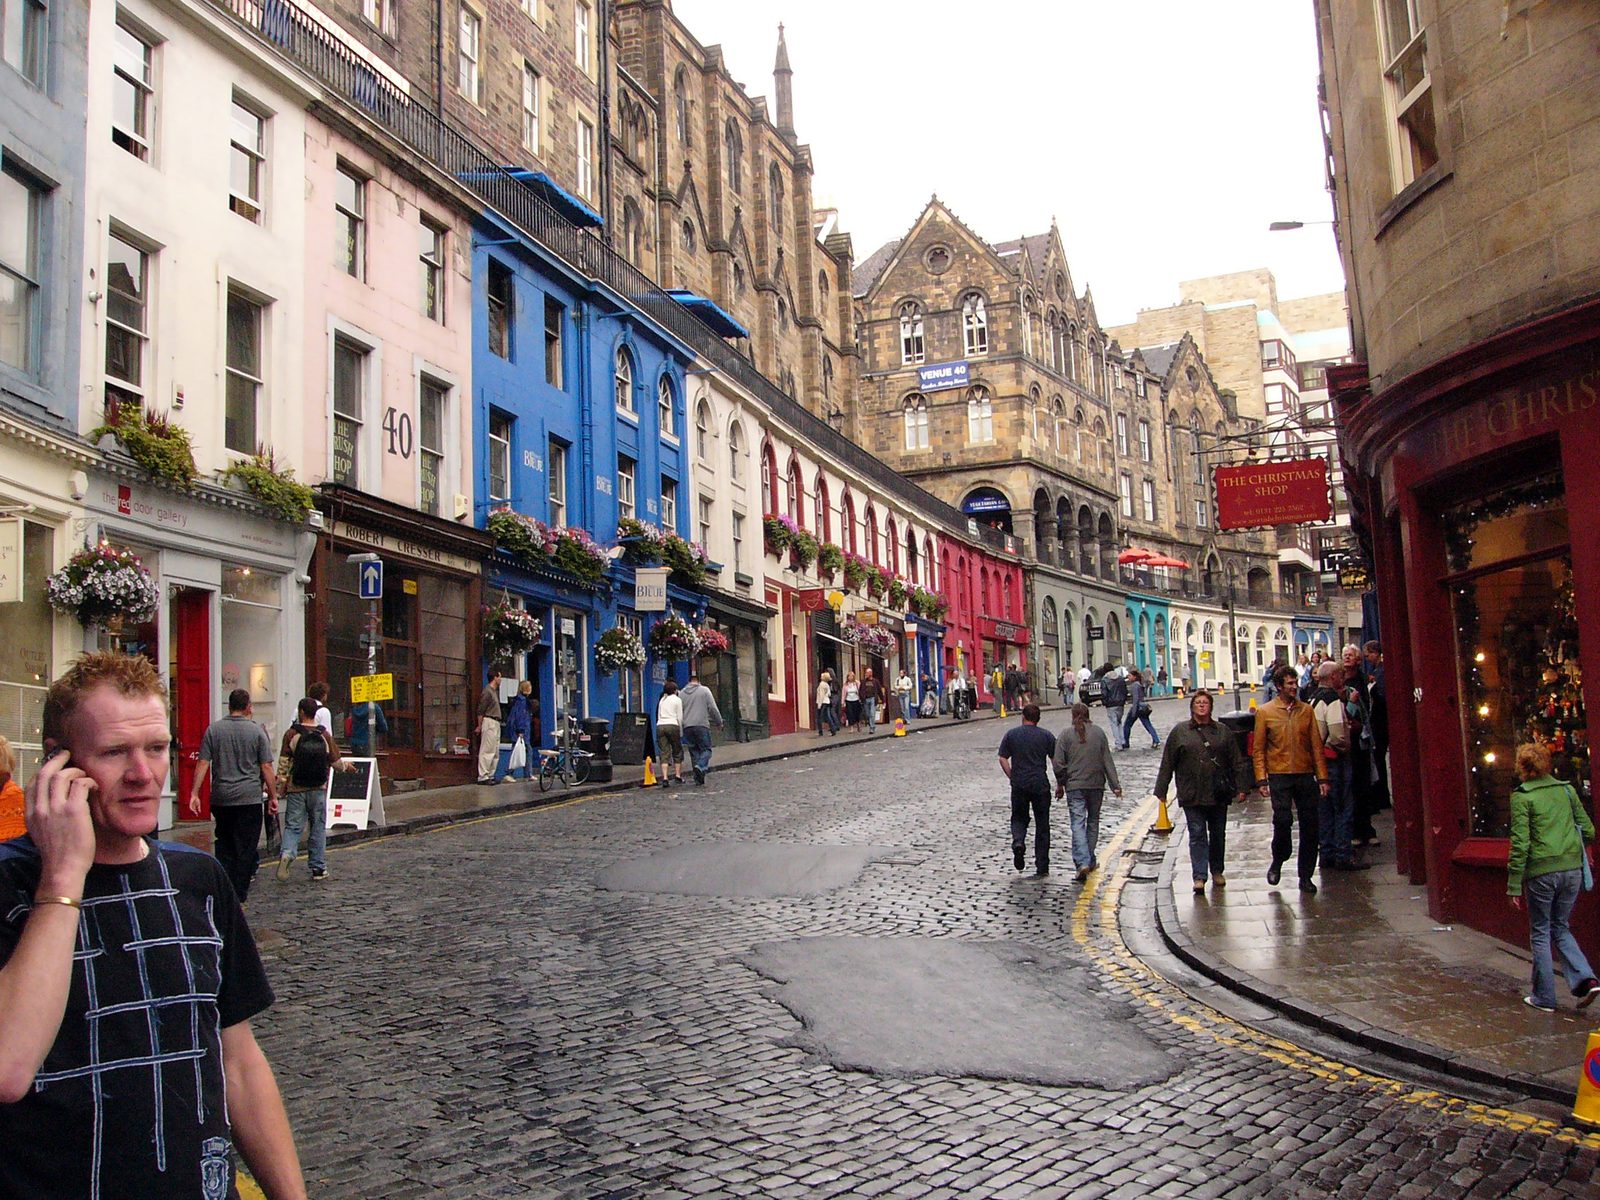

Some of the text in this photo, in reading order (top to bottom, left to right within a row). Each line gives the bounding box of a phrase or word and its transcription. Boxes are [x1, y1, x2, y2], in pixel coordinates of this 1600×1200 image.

[920, 365, 966, 380] VENUE 40
[1487, 371, 1600, 436] CHRIS
[382, 406, 412, 459] 40
[333, 435, 354, 458] RUSH
[334, 455, 352, 475] HOP
[1221, 469, 1321, 488] THE CHRISTMAS
[1255, 485, 1289, 497] SHOP
[102, 492, 116, 506] the
[157, 508, 188, 528] gallery
[345, 525, 385, 547] ROBERT
[397, 541, 441, 563] CRESSER
